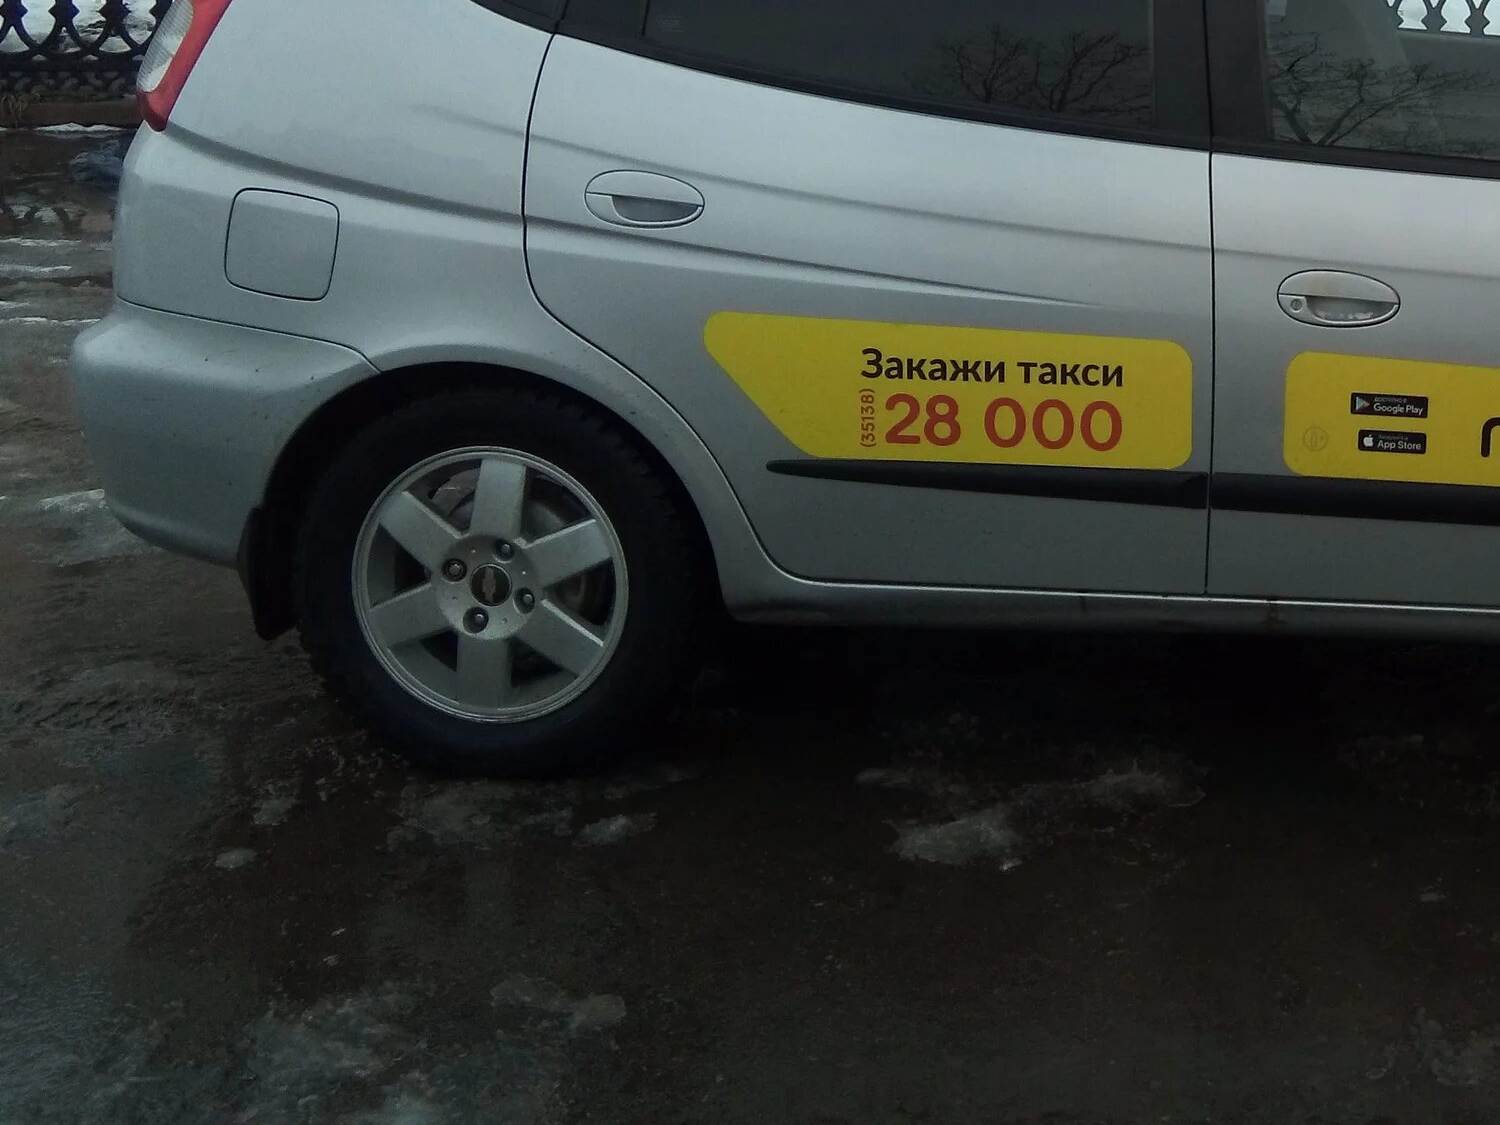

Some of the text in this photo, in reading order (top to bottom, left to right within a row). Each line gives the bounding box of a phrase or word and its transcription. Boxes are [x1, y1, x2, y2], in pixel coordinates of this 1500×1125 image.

[860, 348, 1124, 388] Закажи такси
[858, 388, 876, 448] (35138)
[885, 393, 1123, 452] 28 000
[1373, 402, 1424, 416] Google Play
[1377, 440, 1421, 451] App Store
